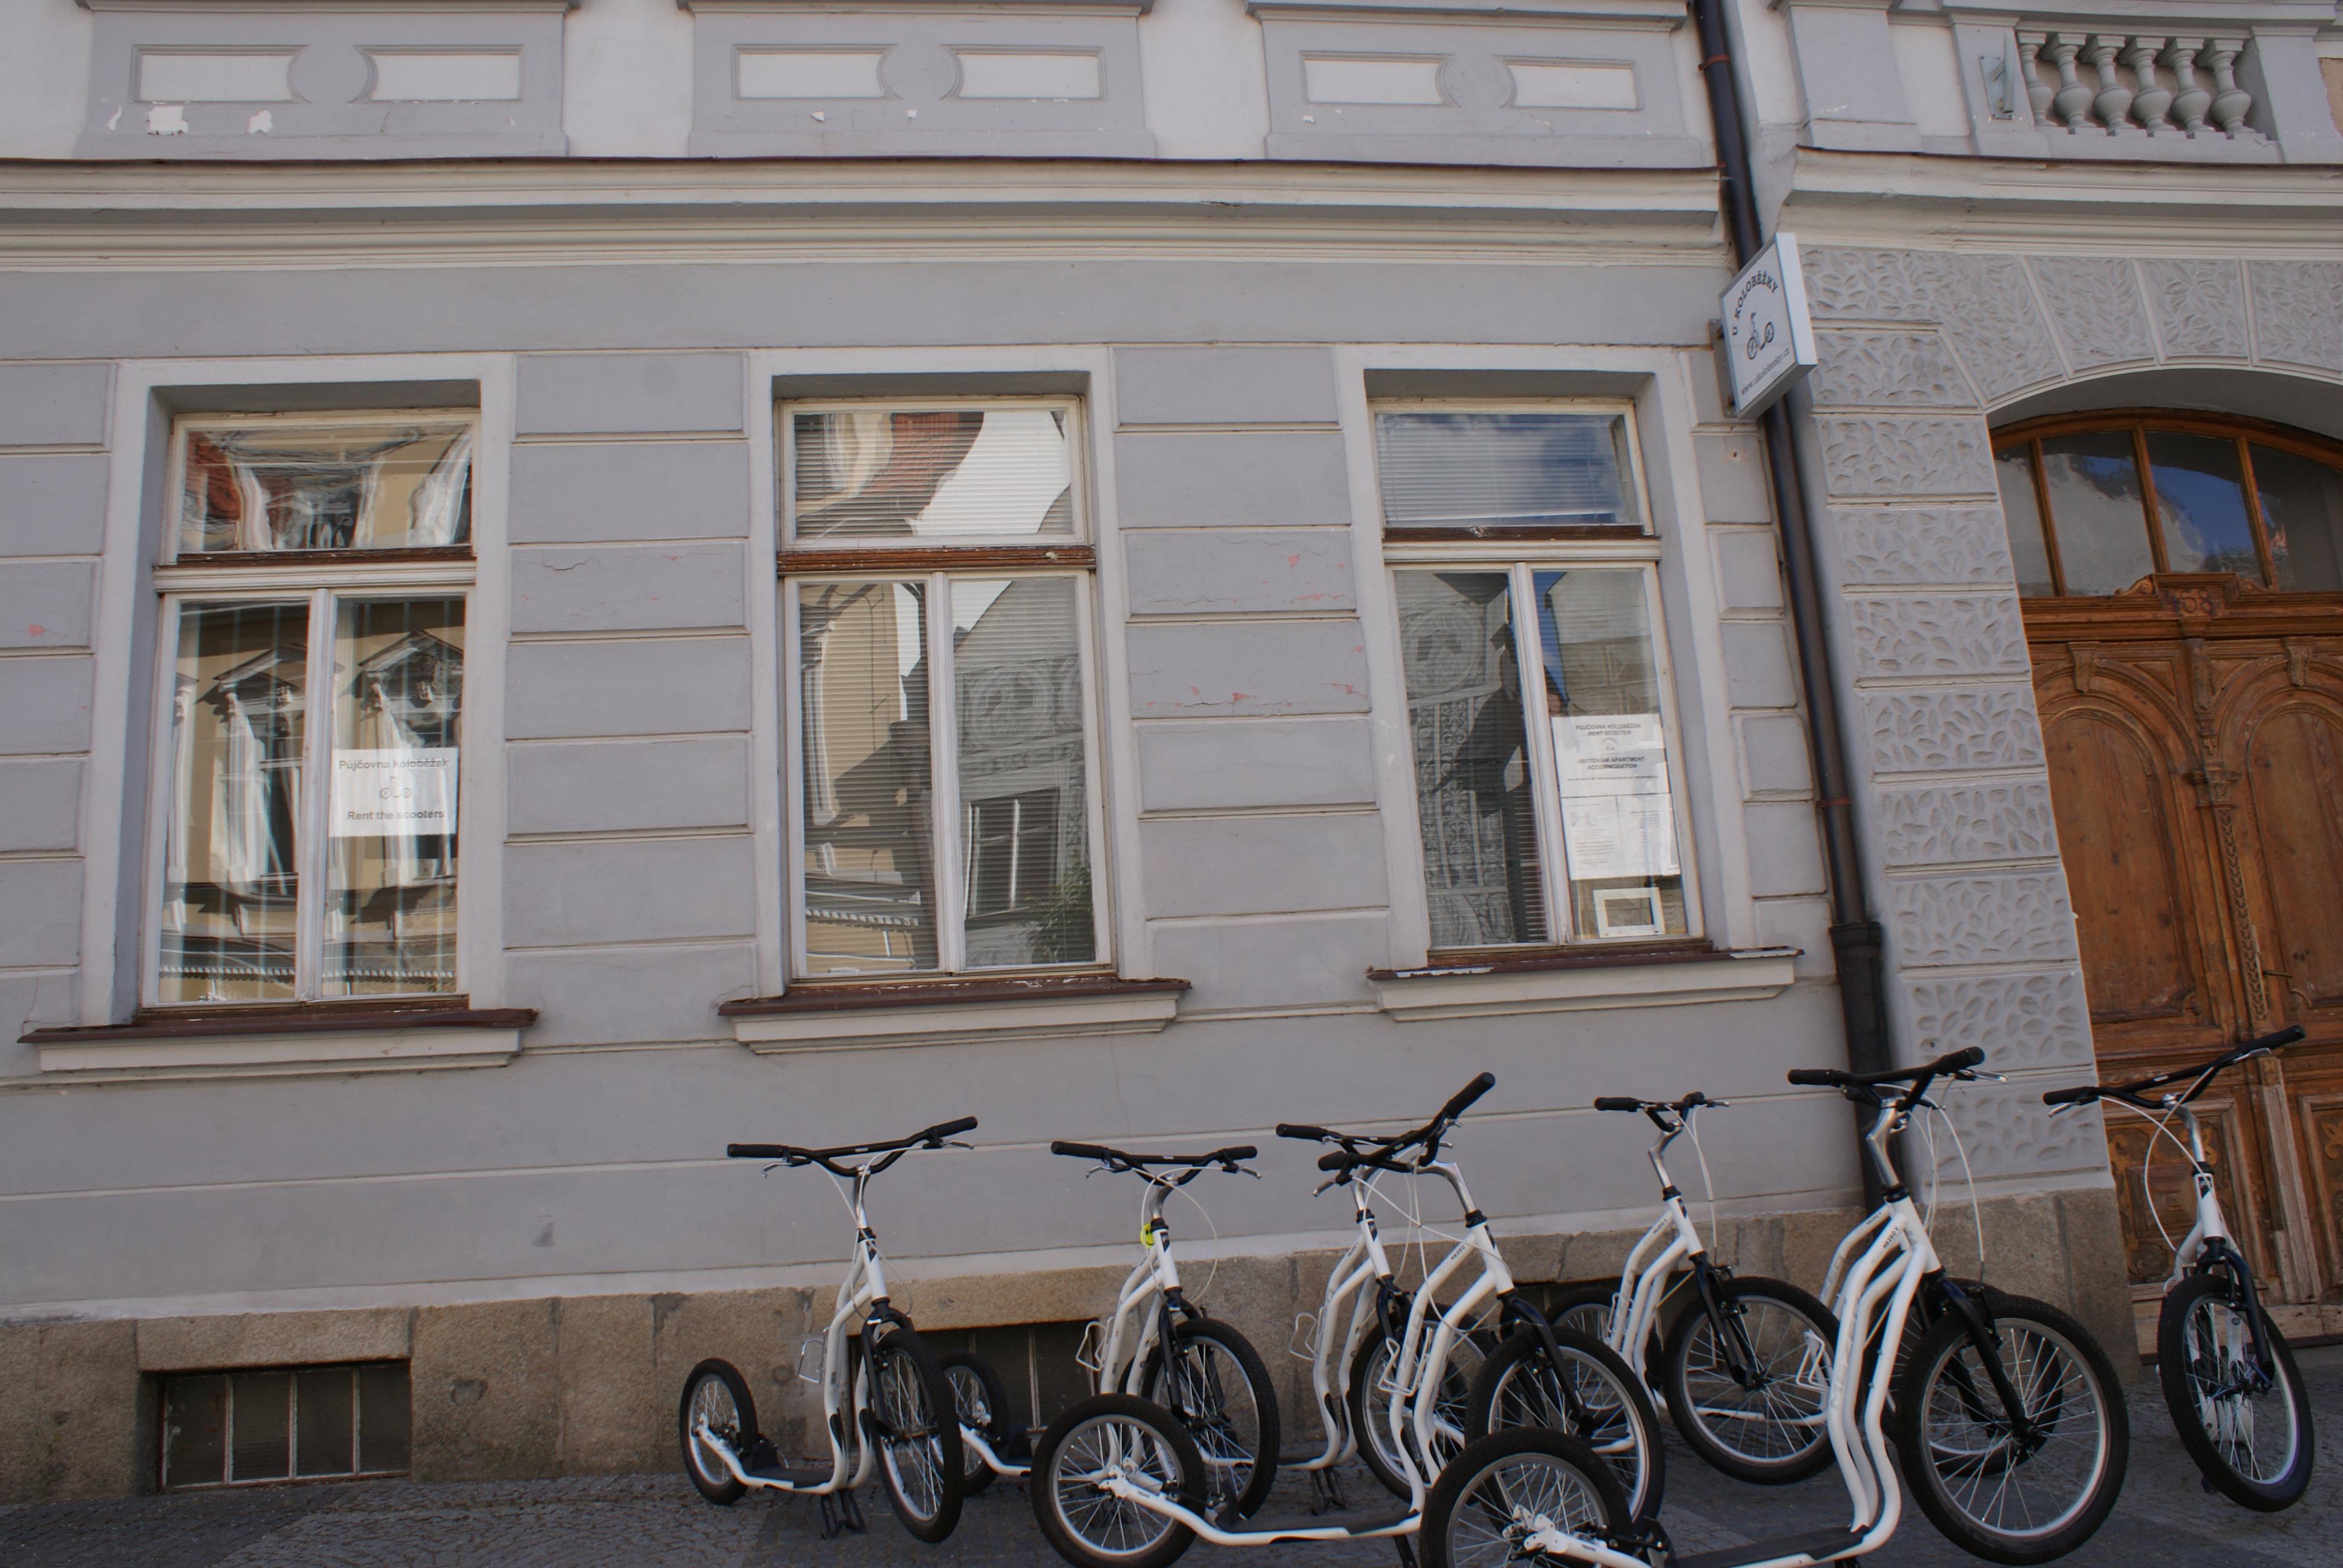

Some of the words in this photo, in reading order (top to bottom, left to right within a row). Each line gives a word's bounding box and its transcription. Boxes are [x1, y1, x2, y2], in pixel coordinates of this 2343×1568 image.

[1734, 270, 1778, 319] KOLOBĚŽKY
[1732, 327, 1738, 336] U
[338, 759, 390, 771] Půjčovna
[393, 758, 449, 768] koloběžek
[347, 811, 373, 820] Rent
[376, 811, 393, 820] the
[396, 810, 445, 820] scooters
